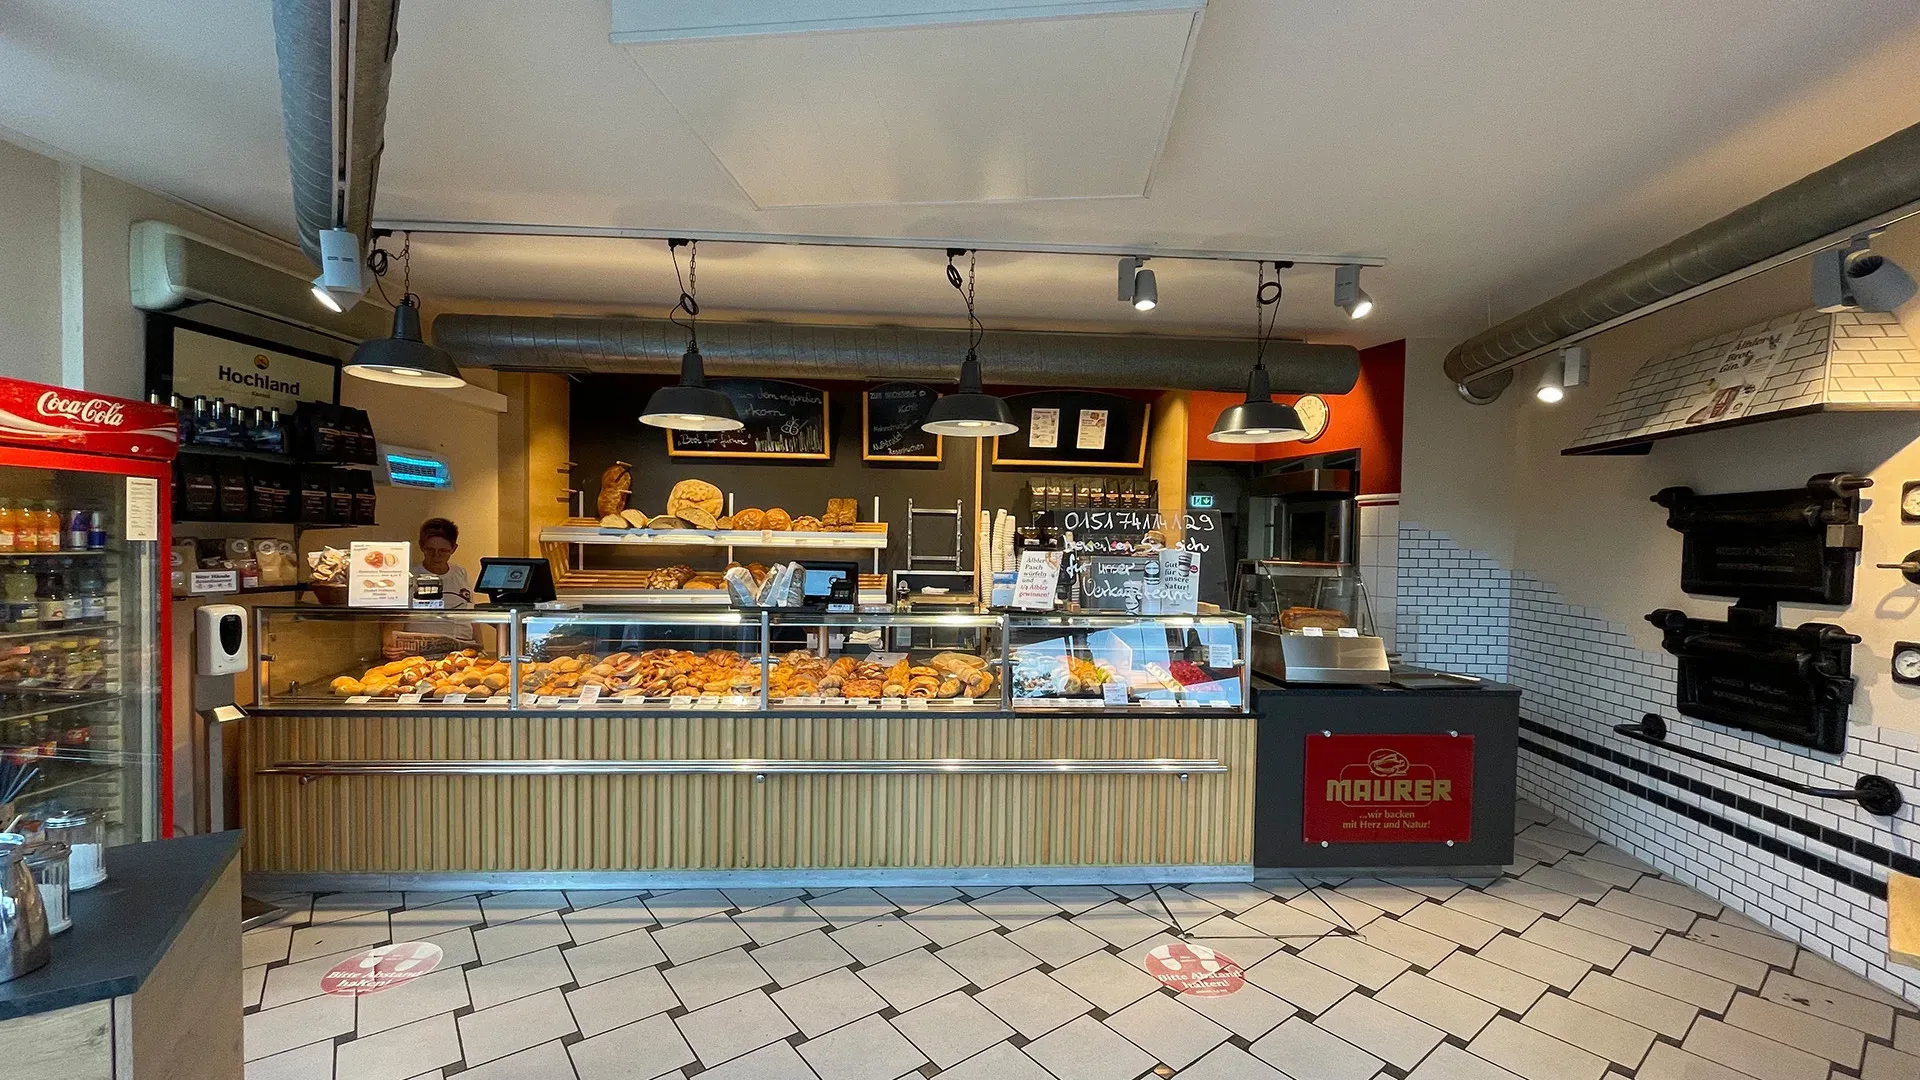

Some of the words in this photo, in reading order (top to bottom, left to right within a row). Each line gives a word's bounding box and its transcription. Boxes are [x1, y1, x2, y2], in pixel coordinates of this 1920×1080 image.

[218, 365, 300, 396] Hochland
[36, 390, 124, 427] Coca-Cola
[1064, 512, 1114, 530] 0151
[1098, 562, 1136, 575] unser
[1164, 568, 1177, 576] für
[1164, 583, 1190, 591] Natur!
[1326, 780, 1453, 802] MAURER
[1384, 810, 1415, 818] backen
[1342, 820, 1357, 829] mit
[1360, 820, 1382, 829] Herz
[1383, 820, 1401, 829] und
[1402, 820, 1431, 829] Natur!
[365, 970, 425, 979] Abstand
[1157, 974, 1189, 982] Bitte
[1191, 969, 1244, 980] Abstand
[336, 979, 393, 988] halten!
[1182, 979, 1229, 989] halten!
